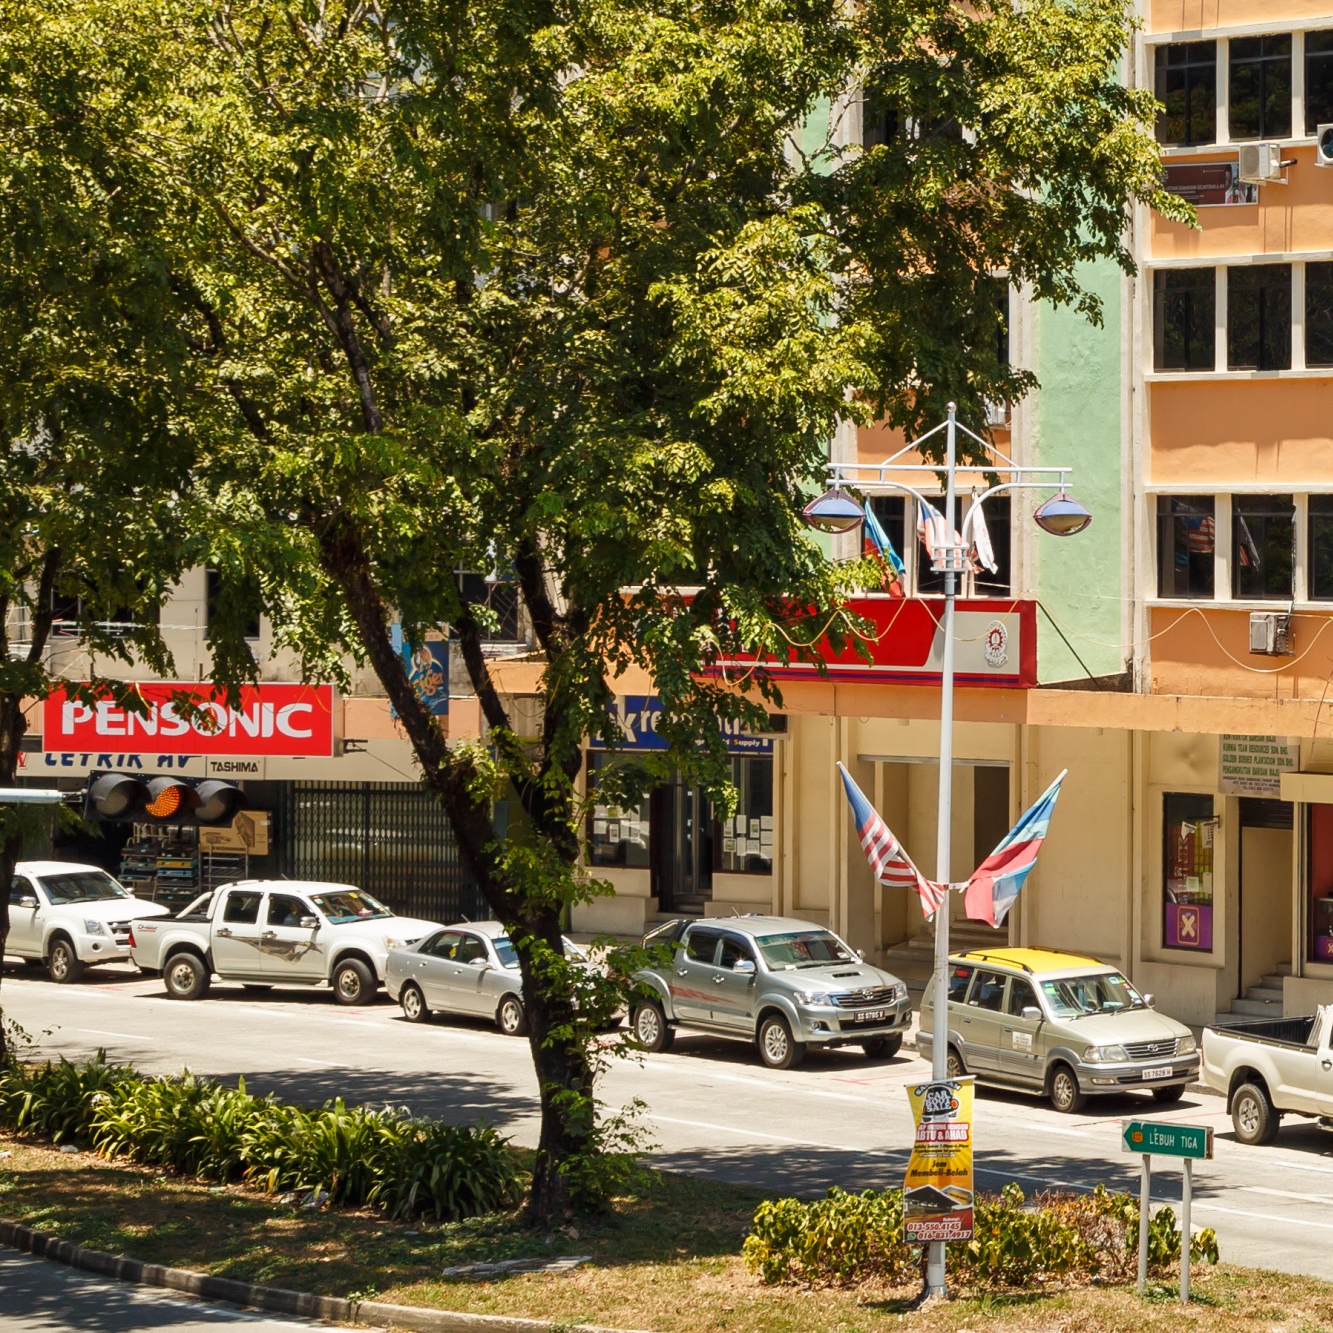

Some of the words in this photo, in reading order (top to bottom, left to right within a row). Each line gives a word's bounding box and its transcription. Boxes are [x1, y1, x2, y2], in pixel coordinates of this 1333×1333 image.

[61, 700, 313, 738] PENSONIC
[733, 738, 760, 748] Supply
[211, 761, 259, 773] TASHIMA
[927, 1091, 947, 1100] CAR
[925, 1096, 951, 1107] BOOT
[926, 1103, 951, 1112] SALE
[1149, 1131, 1175, 1147] LEBUH
[1181, 1135, 1198, 1149] TIGA
